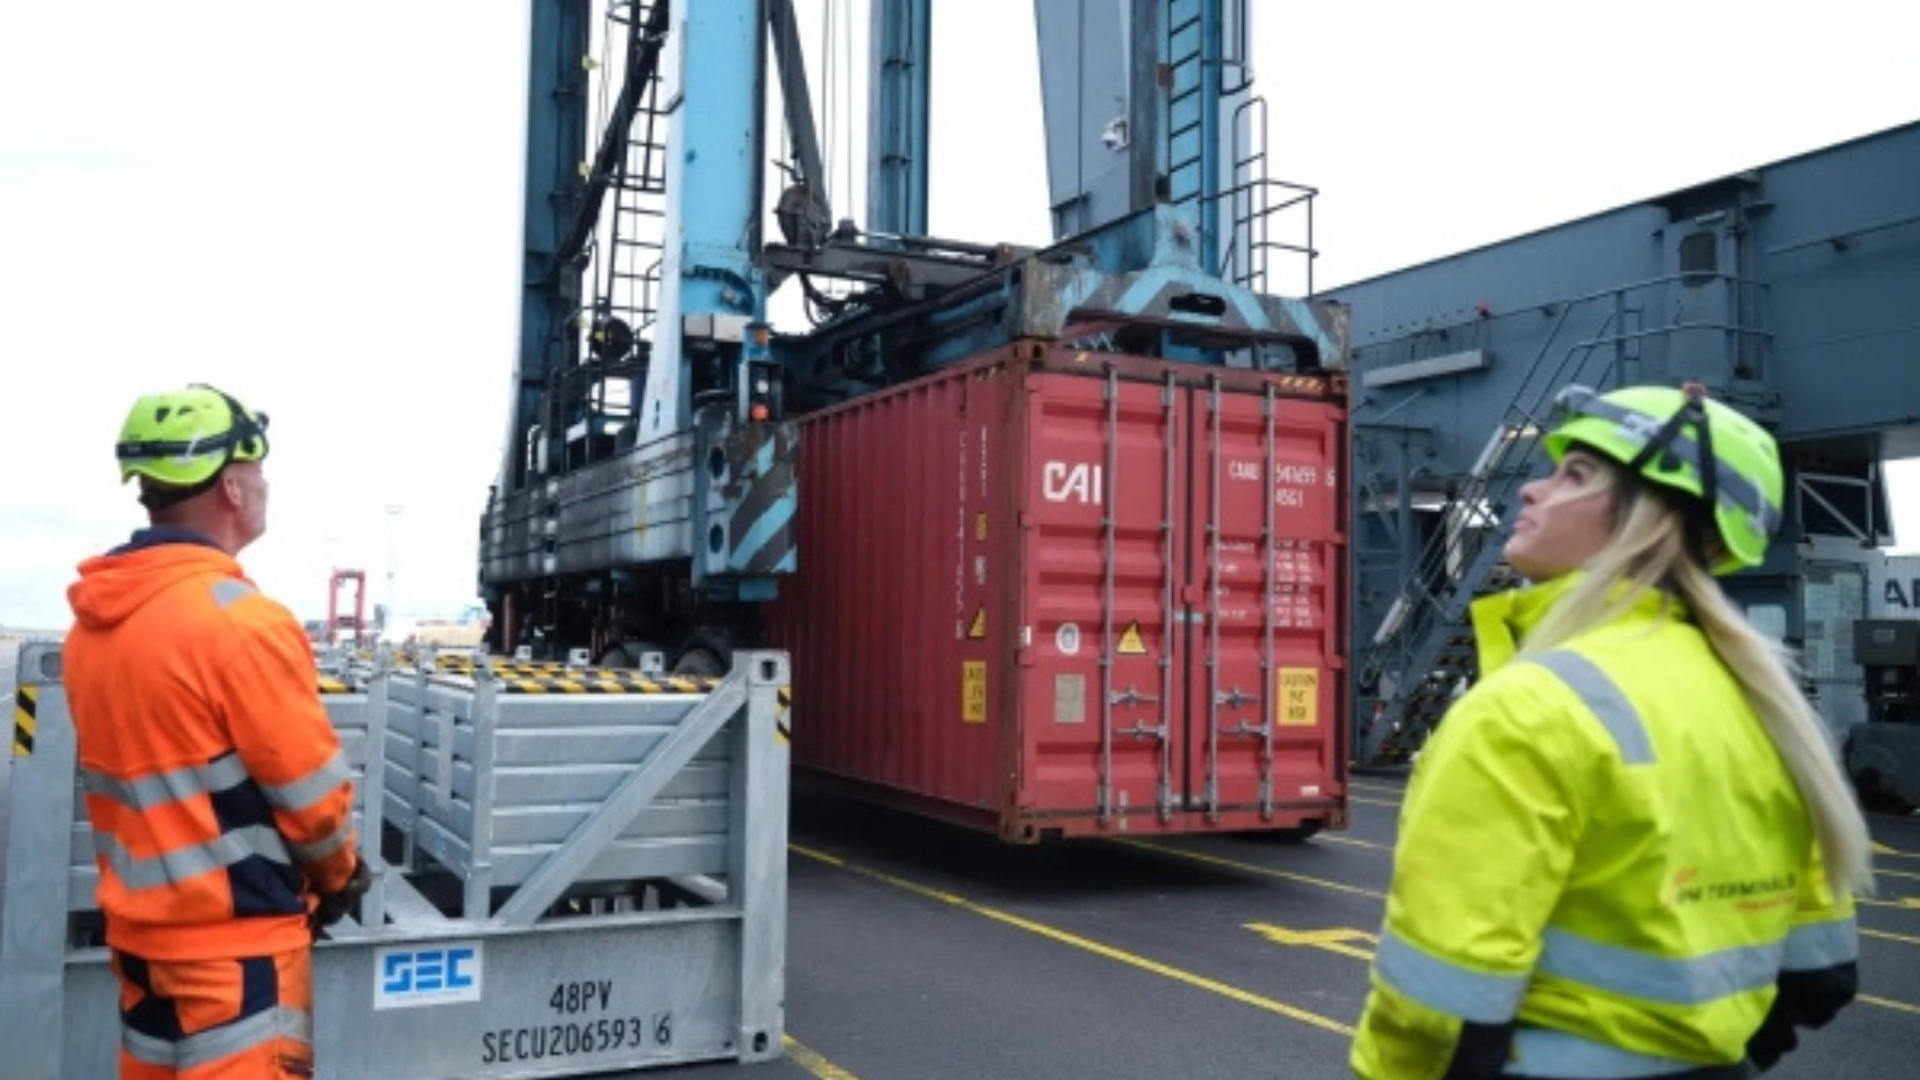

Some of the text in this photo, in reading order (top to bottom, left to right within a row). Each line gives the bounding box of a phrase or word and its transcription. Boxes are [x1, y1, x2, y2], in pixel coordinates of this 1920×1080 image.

[1042, 461, 1102, 505] CAI
[383, 948, 475, 994] SEC
[549, 980, 612, 1014] 48PV
[482, 1011, 672, 1064] SECU206593 6
